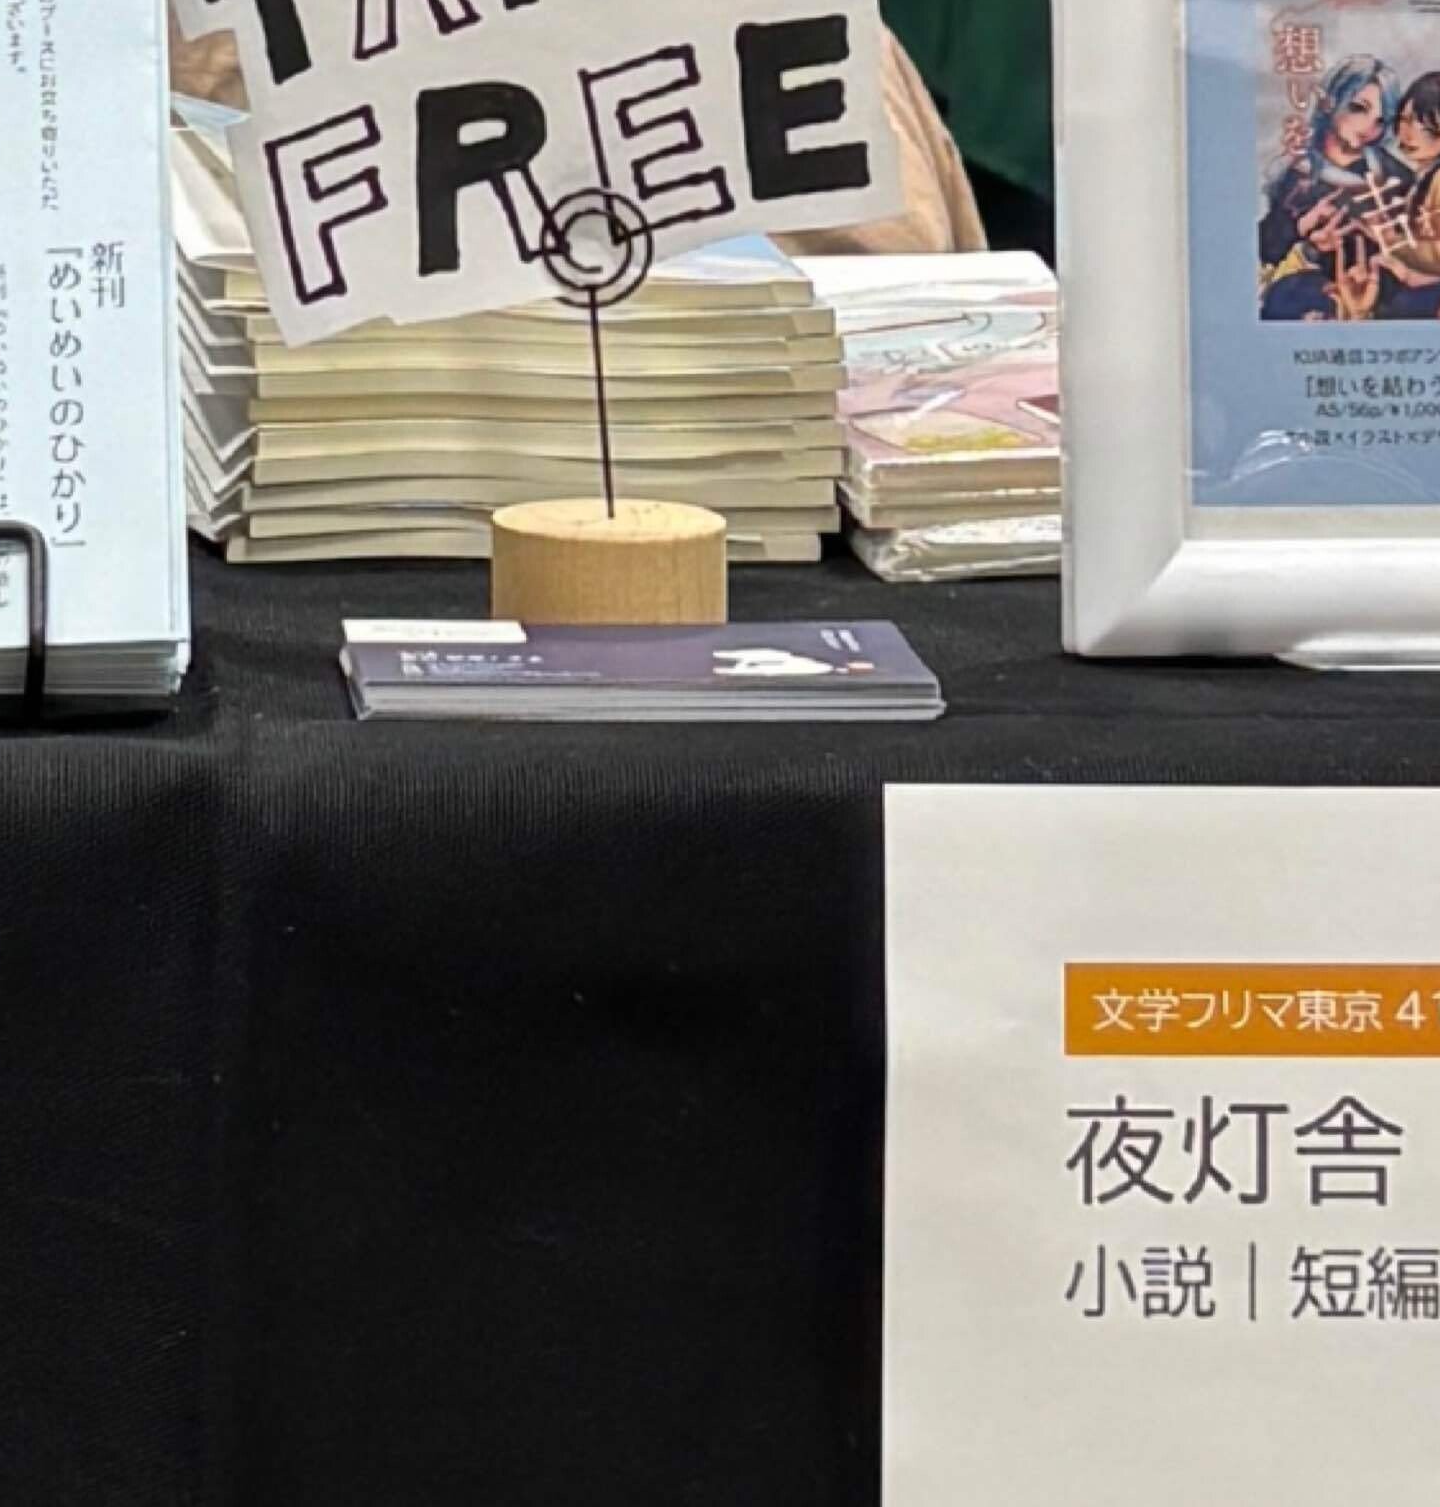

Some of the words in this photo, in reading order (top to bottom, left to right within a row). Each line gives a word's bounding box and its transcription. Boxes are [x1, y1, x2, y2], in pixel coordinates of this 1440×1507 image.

[263, 13, 873, 305] FREE
[90, 241, 127, 309] 新刊
[45, 245, 88, 549] 『めいめいのひかり』
[1091, 985, 1383, 1038] 文学フリマ東京
[1065, 1096, 1406, 1210] 夜灯舎
